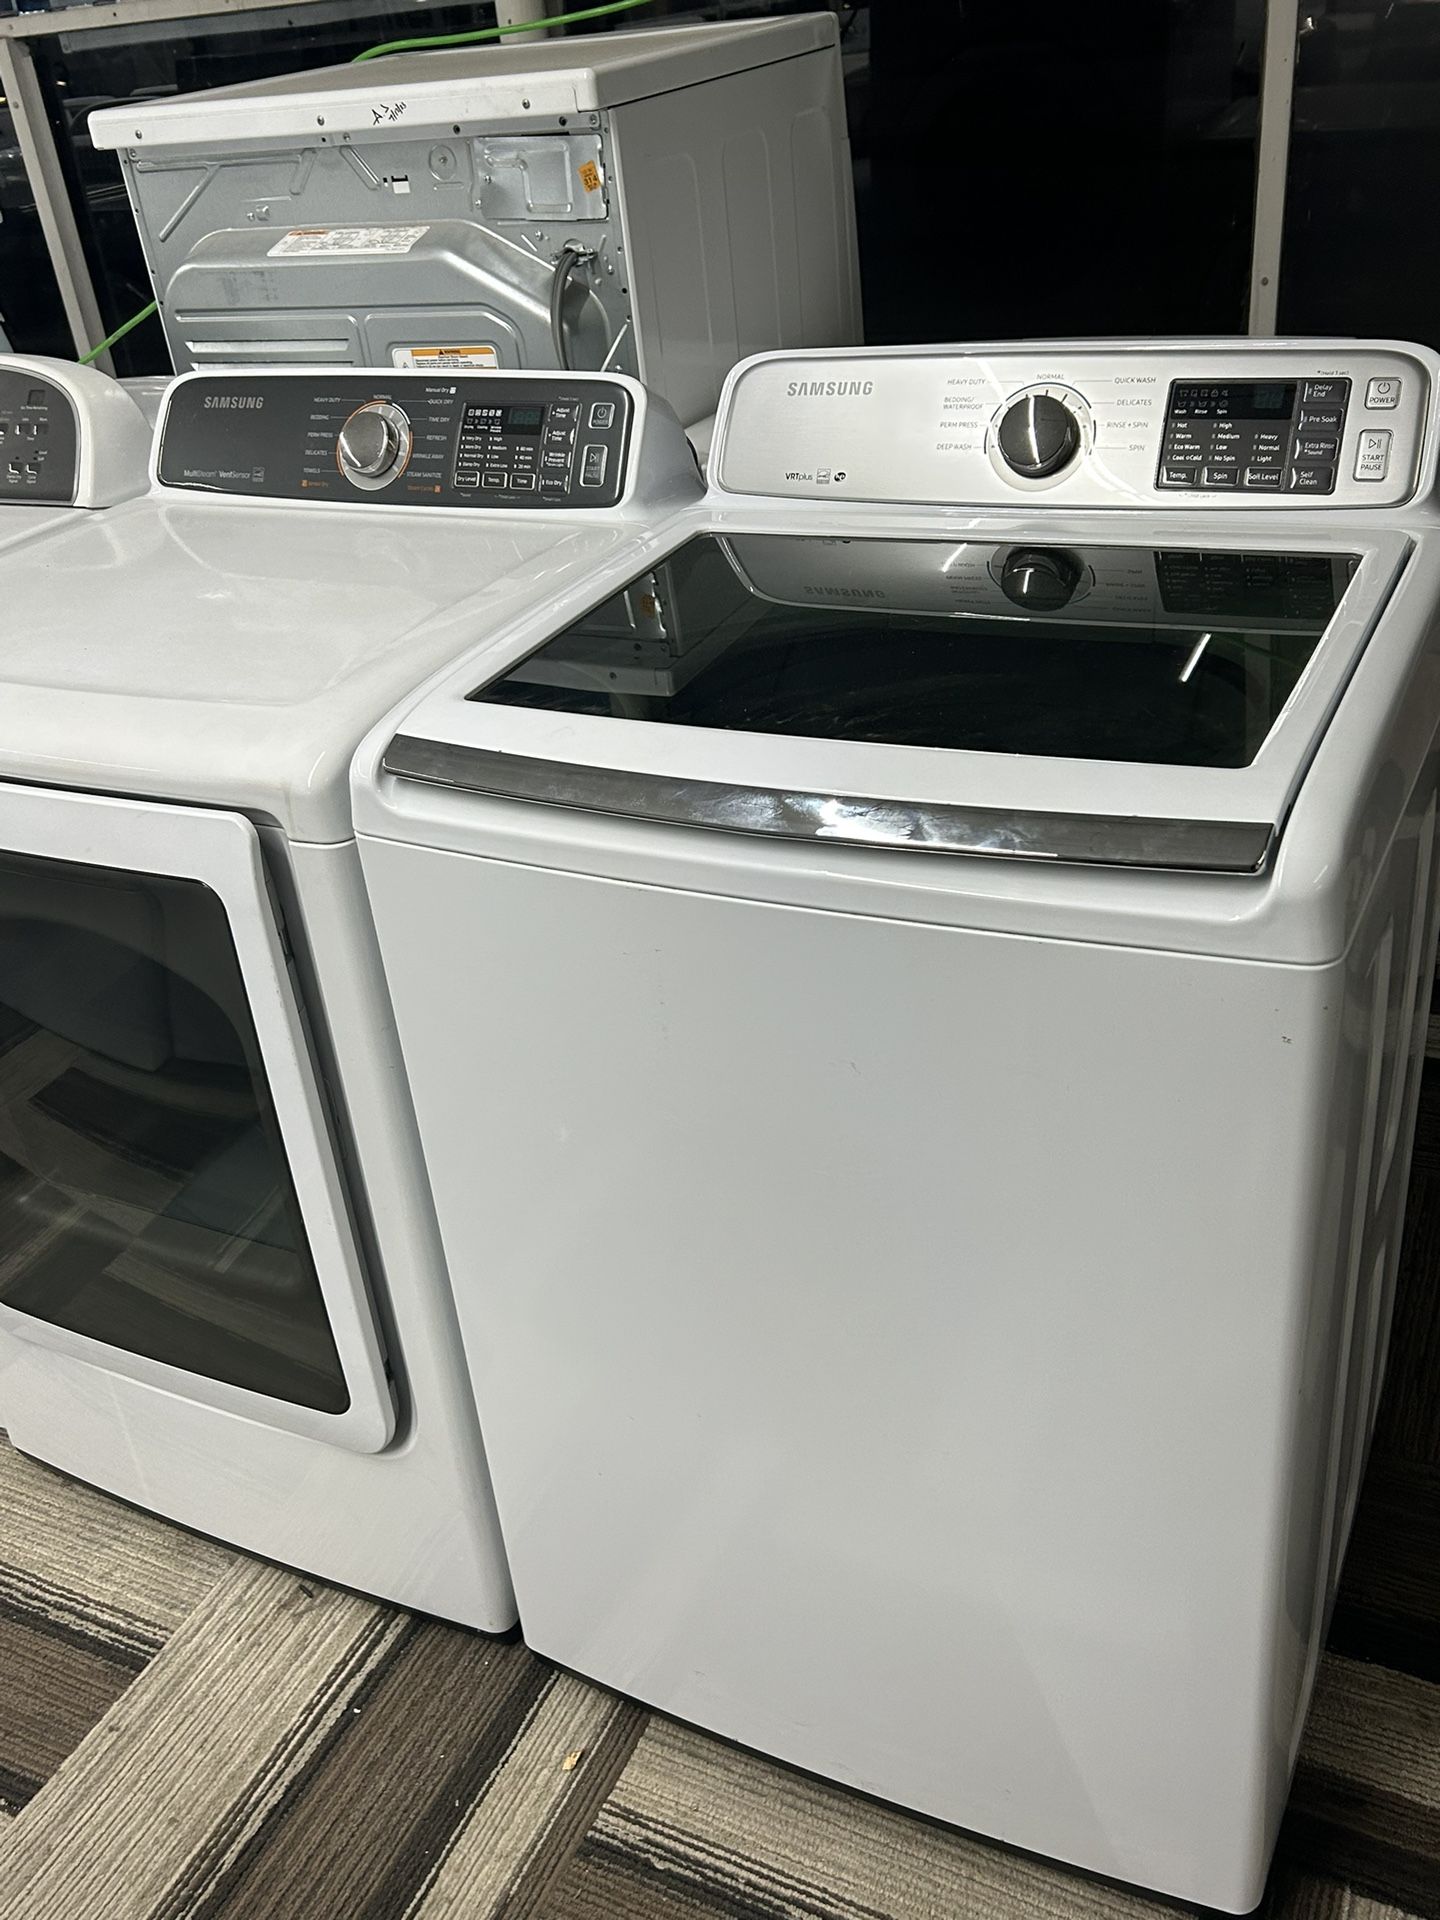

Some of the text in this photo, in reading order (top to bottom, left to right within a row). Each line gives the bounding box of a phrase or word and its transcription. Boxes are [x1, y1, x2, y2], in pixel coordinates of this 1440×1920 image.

[1114, 376, 1156, 384] QUICK WASH
[786, 381, 874, 397] SAMSUNG
[203, 396, 264, 409] SAMSUNG
[939, 421, 957, 429] PERM
[1219, 422, 1232, 430] High
[1257, 455, 1272, 463] Light
[1360, 463, 1383, 471] PAUSE
[784, 472, 813, 481] VRTplus
[1169, 471, 1188, 479] Temp.
[1213, 472, 1228, 480] Spin
